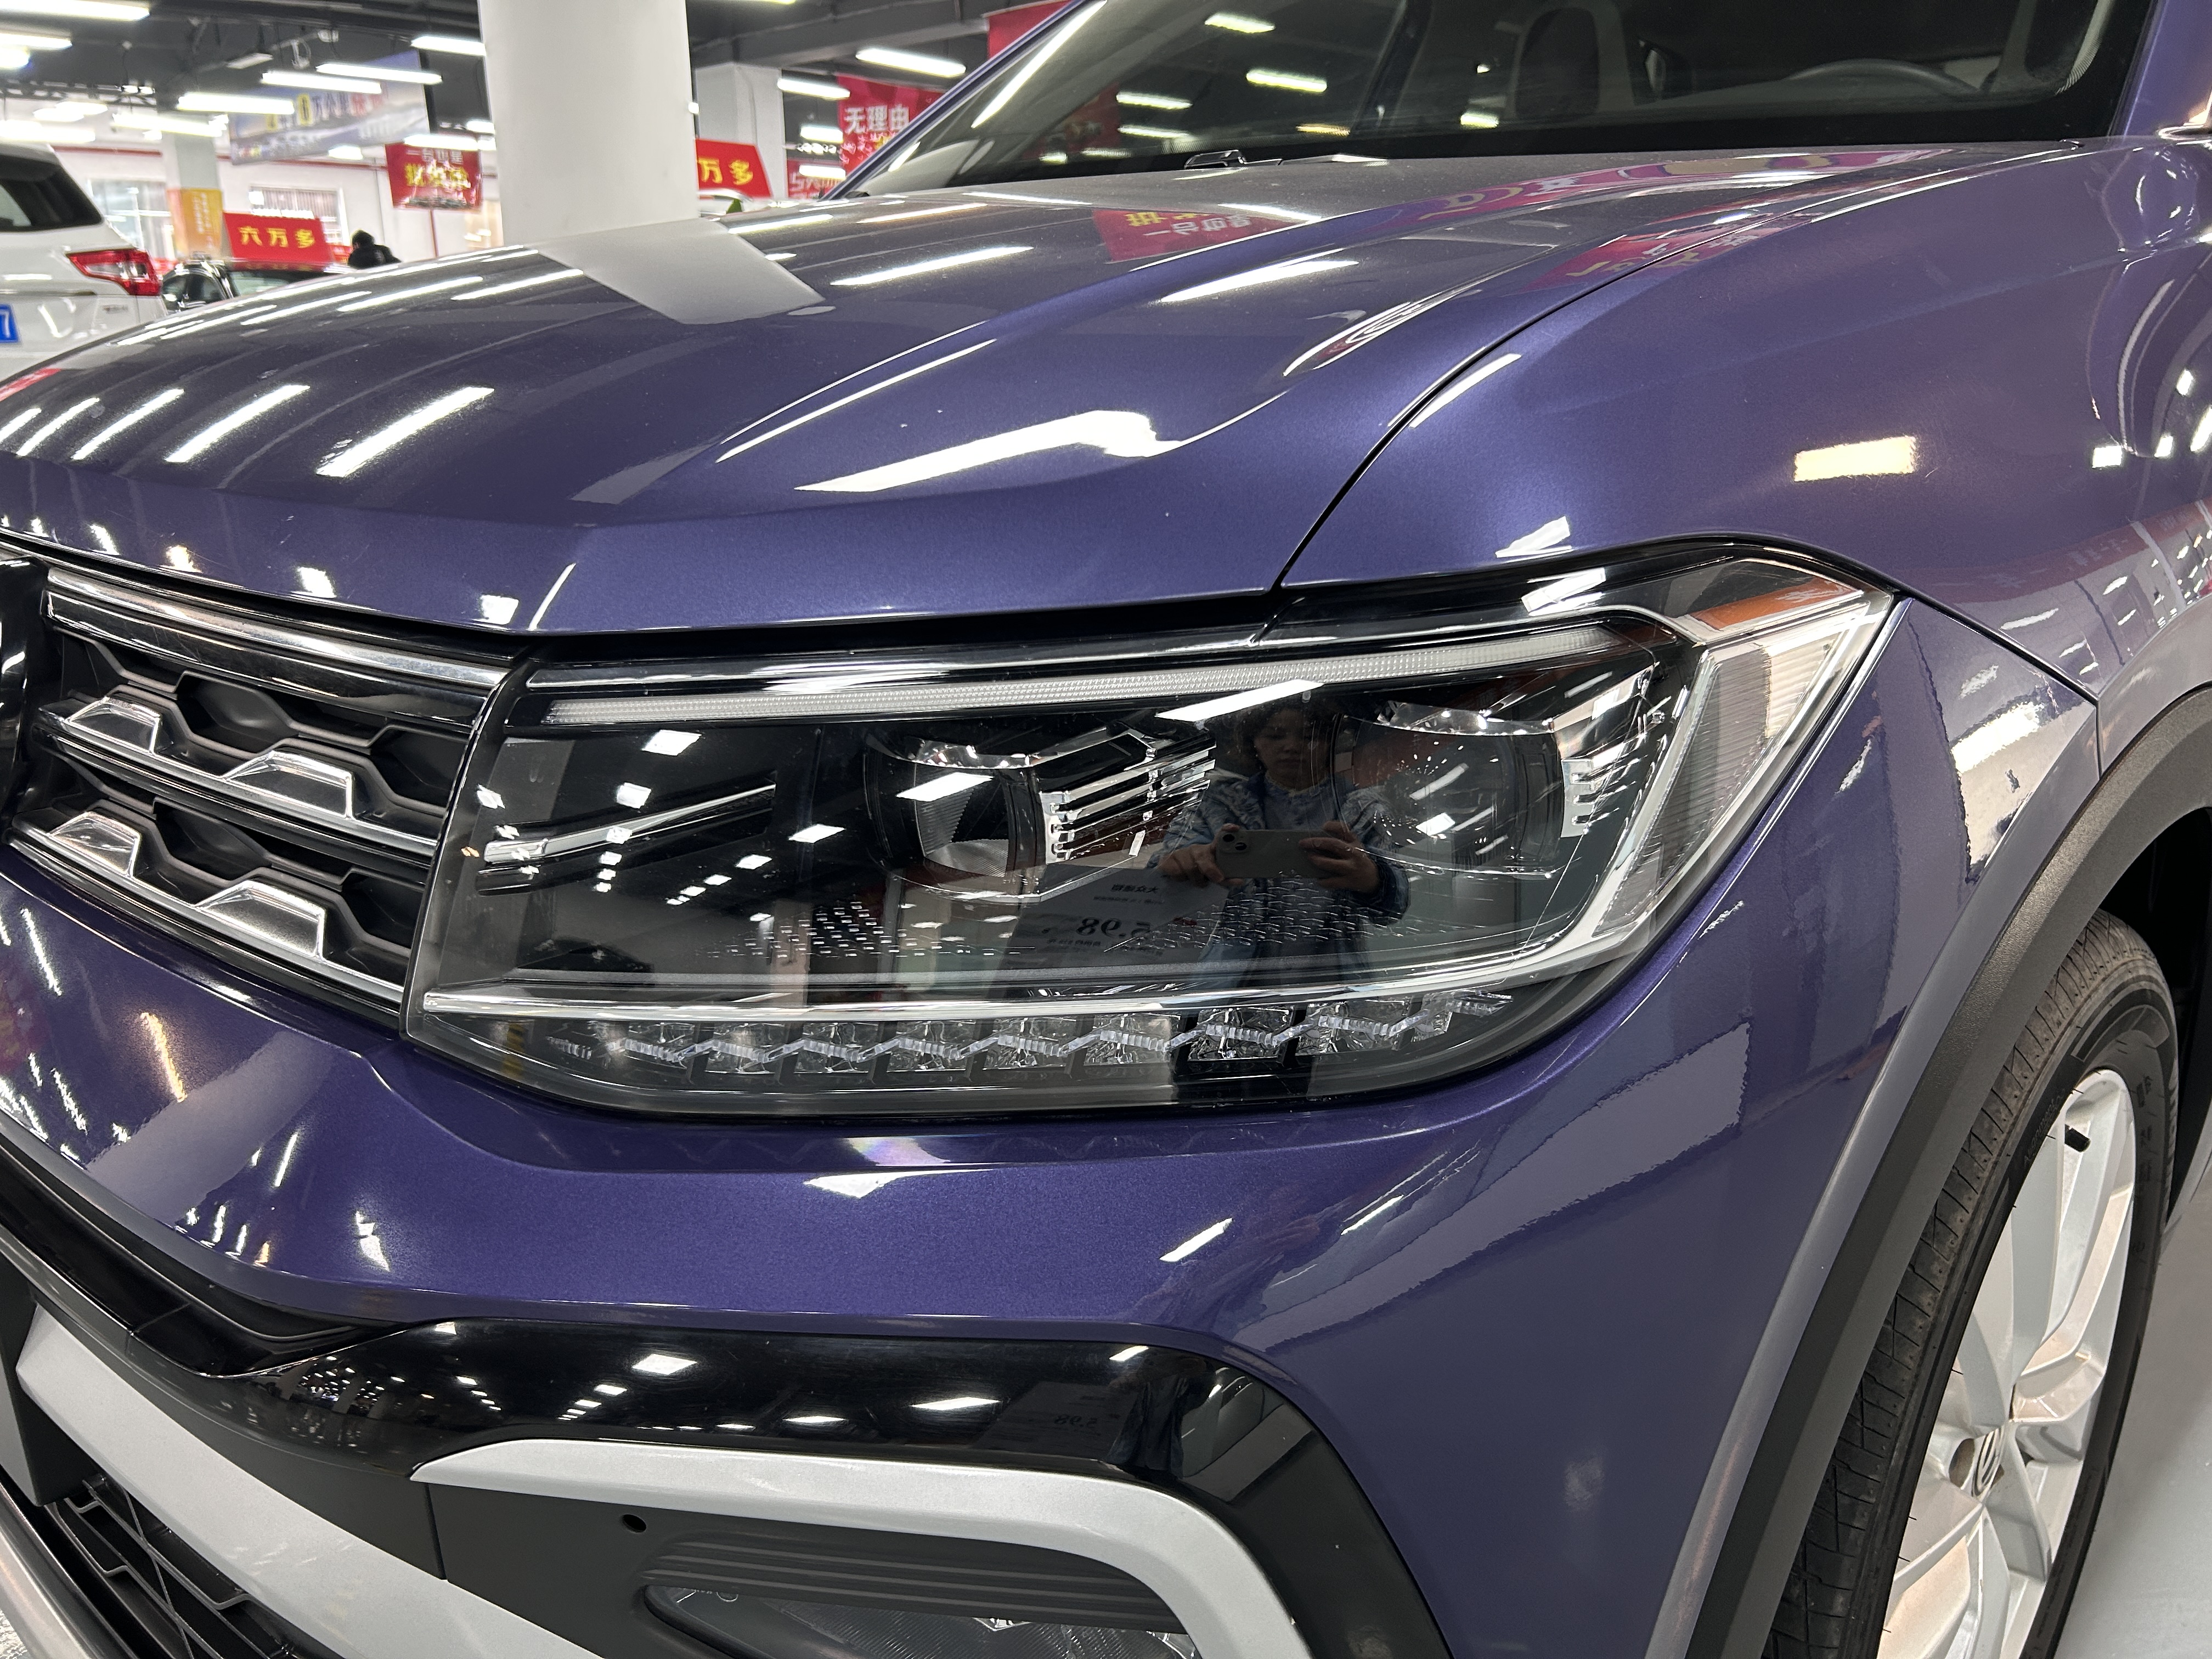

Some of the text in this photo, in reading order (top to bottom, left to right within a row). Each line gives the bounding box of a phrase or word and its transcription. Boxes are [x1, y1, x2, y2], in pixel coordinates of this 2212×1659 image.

[844, 104, 910, 135] 无理由
[697, 157, 753, 185] 万多
[238, 225, 315, 249] 六万多
